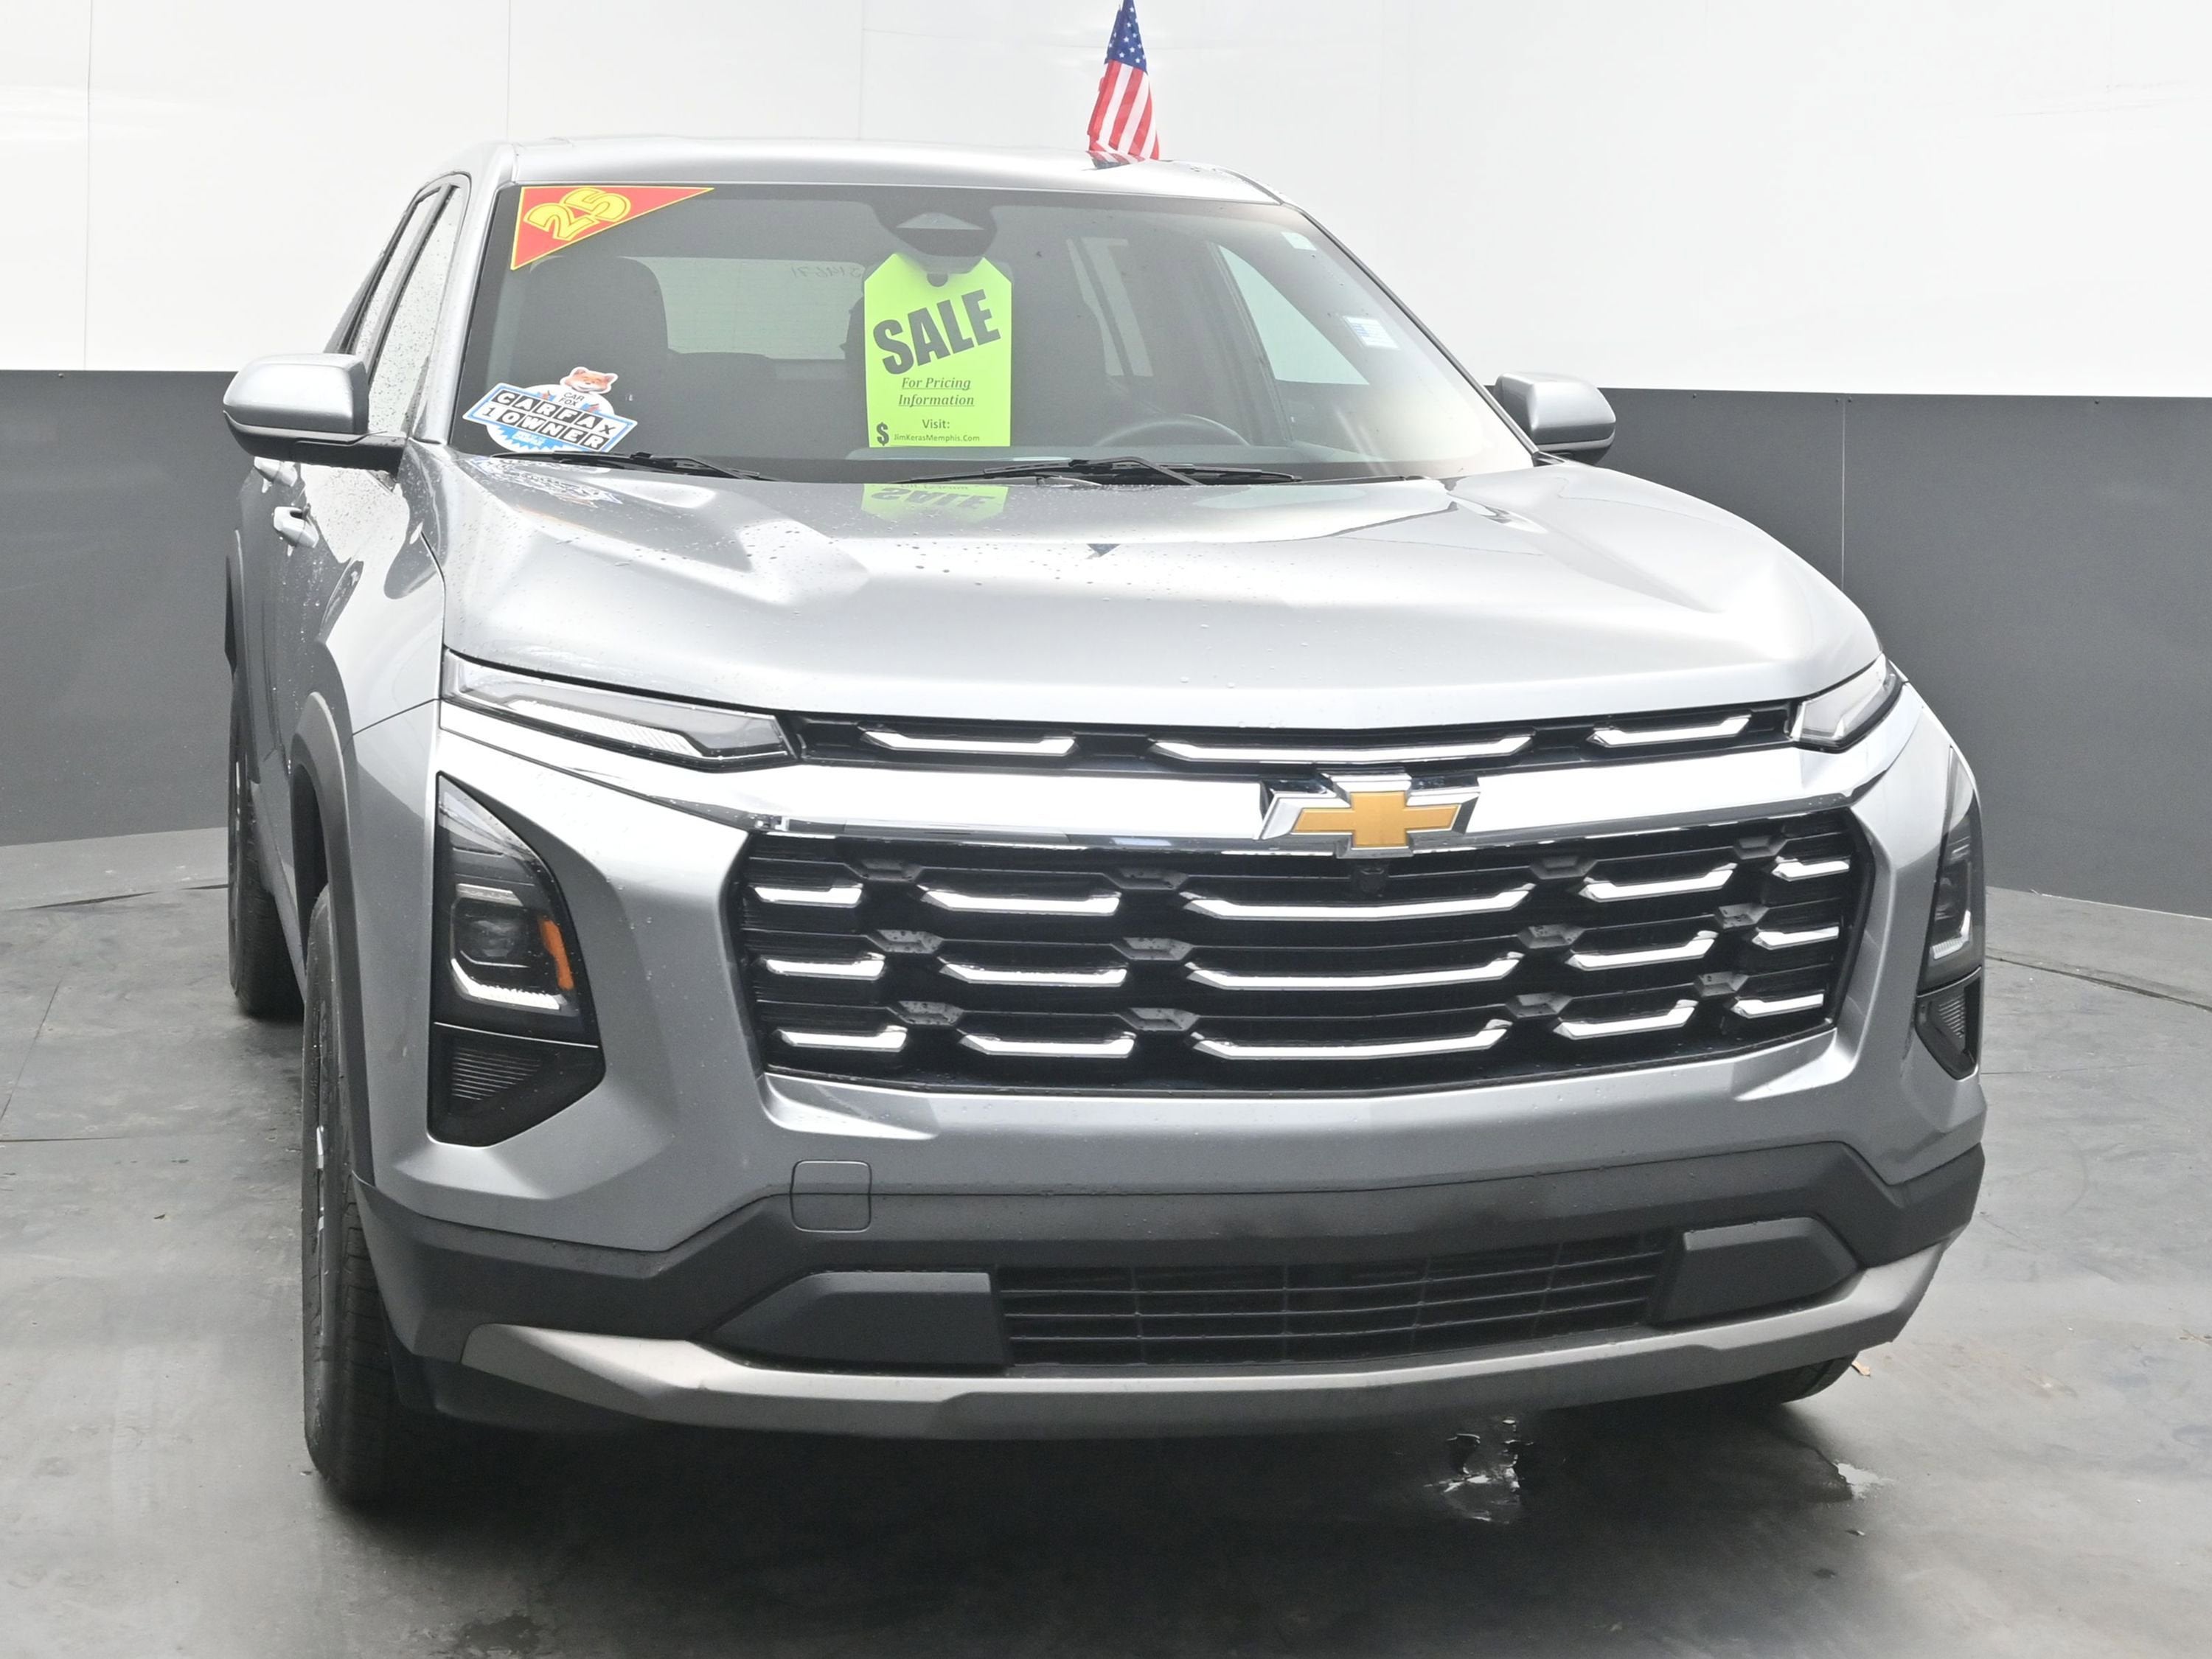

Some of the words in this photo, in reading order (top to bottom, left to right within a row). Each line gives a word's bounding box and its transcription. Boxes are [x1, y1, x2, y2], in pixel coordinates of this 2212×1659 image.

[524, 187, 631, 240] 25
[873, 288, 1001, 375] SALE
[901, 377, 922, 389] For
[925, 377, 971, 390] Pricing
[558, 397, 578, 406] FOX
[563, 392, 585, 401] CAR
[898, 394, 975, 407] Information
[495, 391, 616, 435] CARFAX
[481, 407, 495, 417] 1
[500, 411, 607, 449] OWNER
[922, 419, 950, 429] Visit:
[877, 422, 889, 446] $
